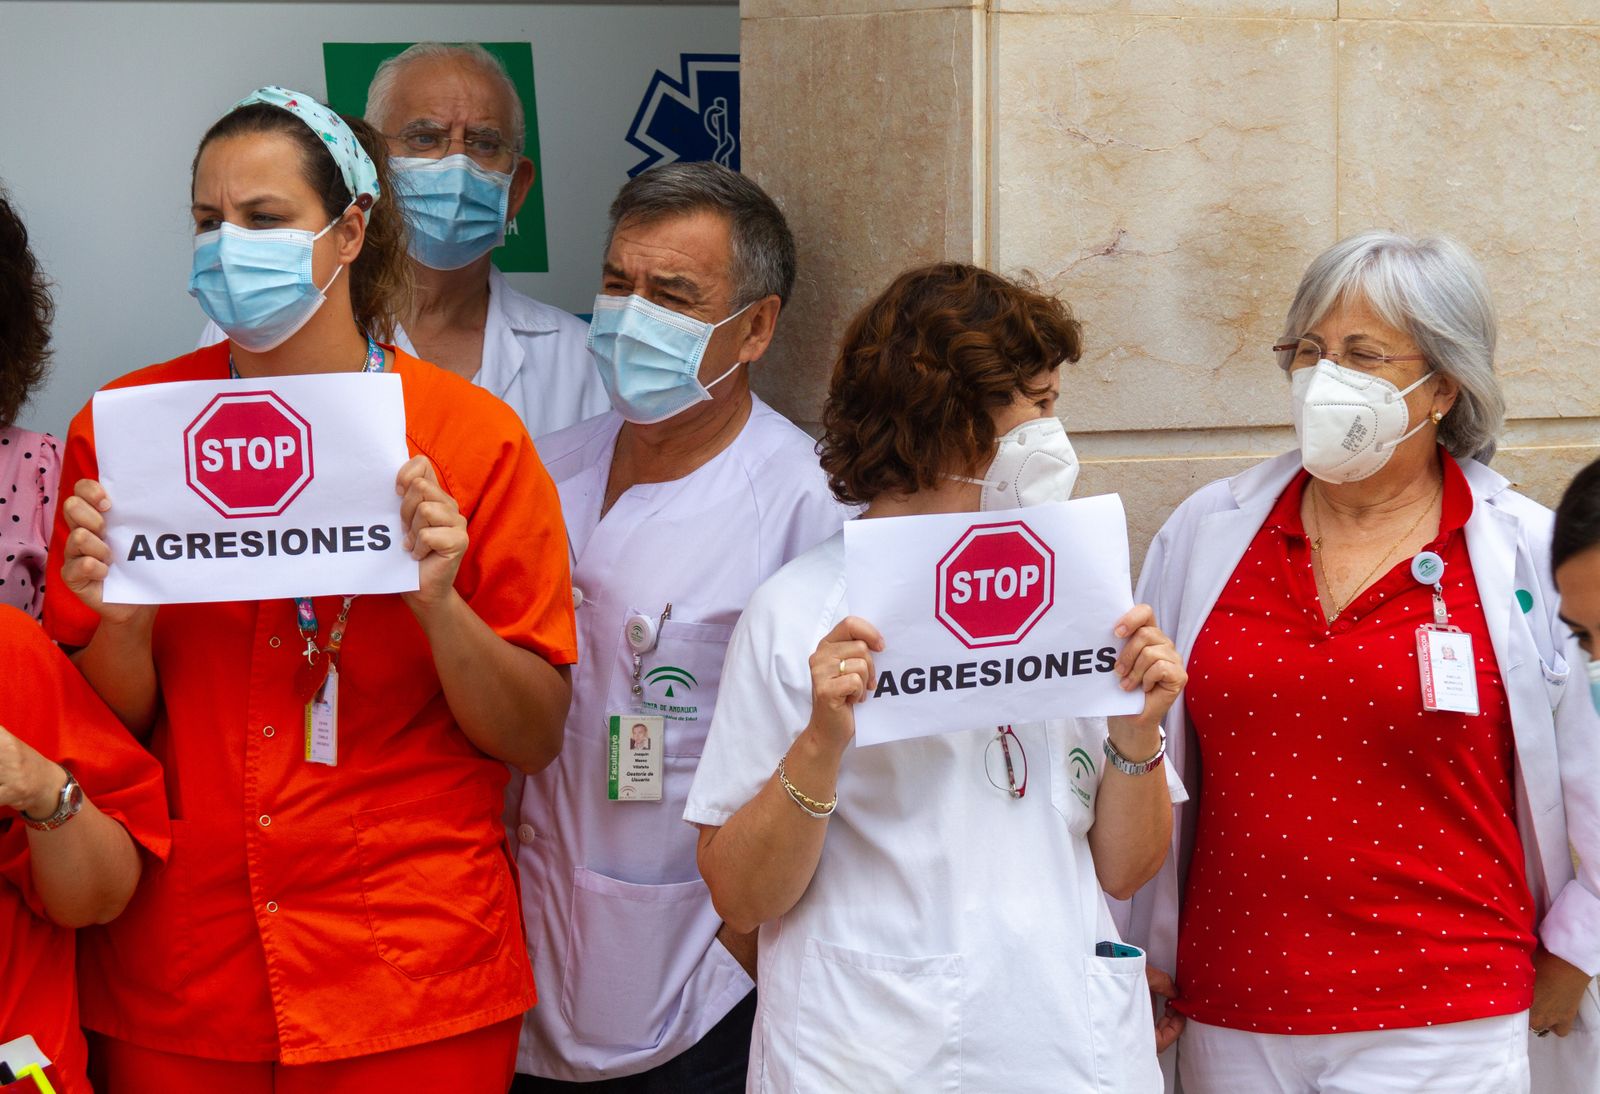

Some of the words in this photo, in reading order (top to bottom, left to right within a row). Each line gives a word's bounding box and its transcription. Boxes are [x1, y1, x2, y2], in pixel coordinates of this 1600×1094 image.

[201, 435, 297, 473] STOP
[127, 524, 391, 562] AGRESIONES
[951, 564, 1040, 604] STOP
[873, 646, 1117, 699] AGRESIONES
[610, 735, 619, 781] Facultativo
